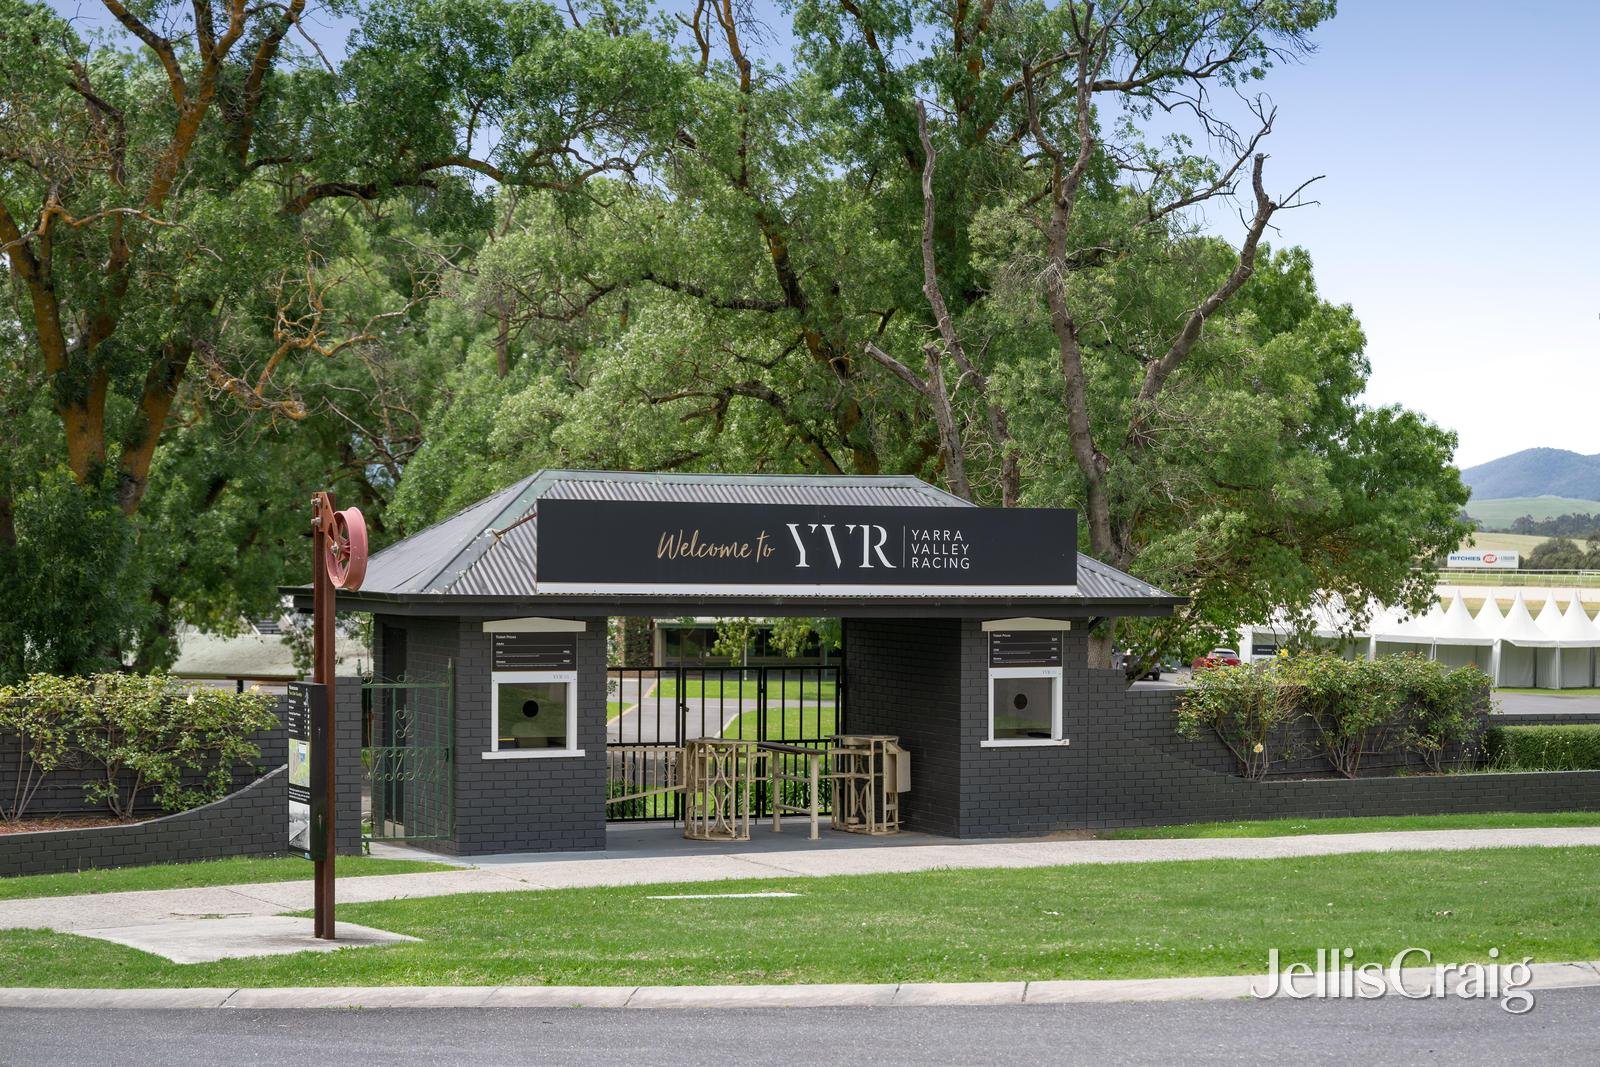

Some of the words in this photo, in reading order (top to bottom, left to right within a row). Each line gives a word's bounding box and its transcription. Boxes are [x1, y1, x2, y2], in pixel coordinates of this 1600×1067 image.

[911, 529, 964, 542] YARRA
[658, 530, 752, 562] Welcome
[757, 530, 776, 564] to
[785, 523, 898, 569] YVR
[911, 543, 971, 556] VALLEY
[911, 556, 971, 570] RACING
